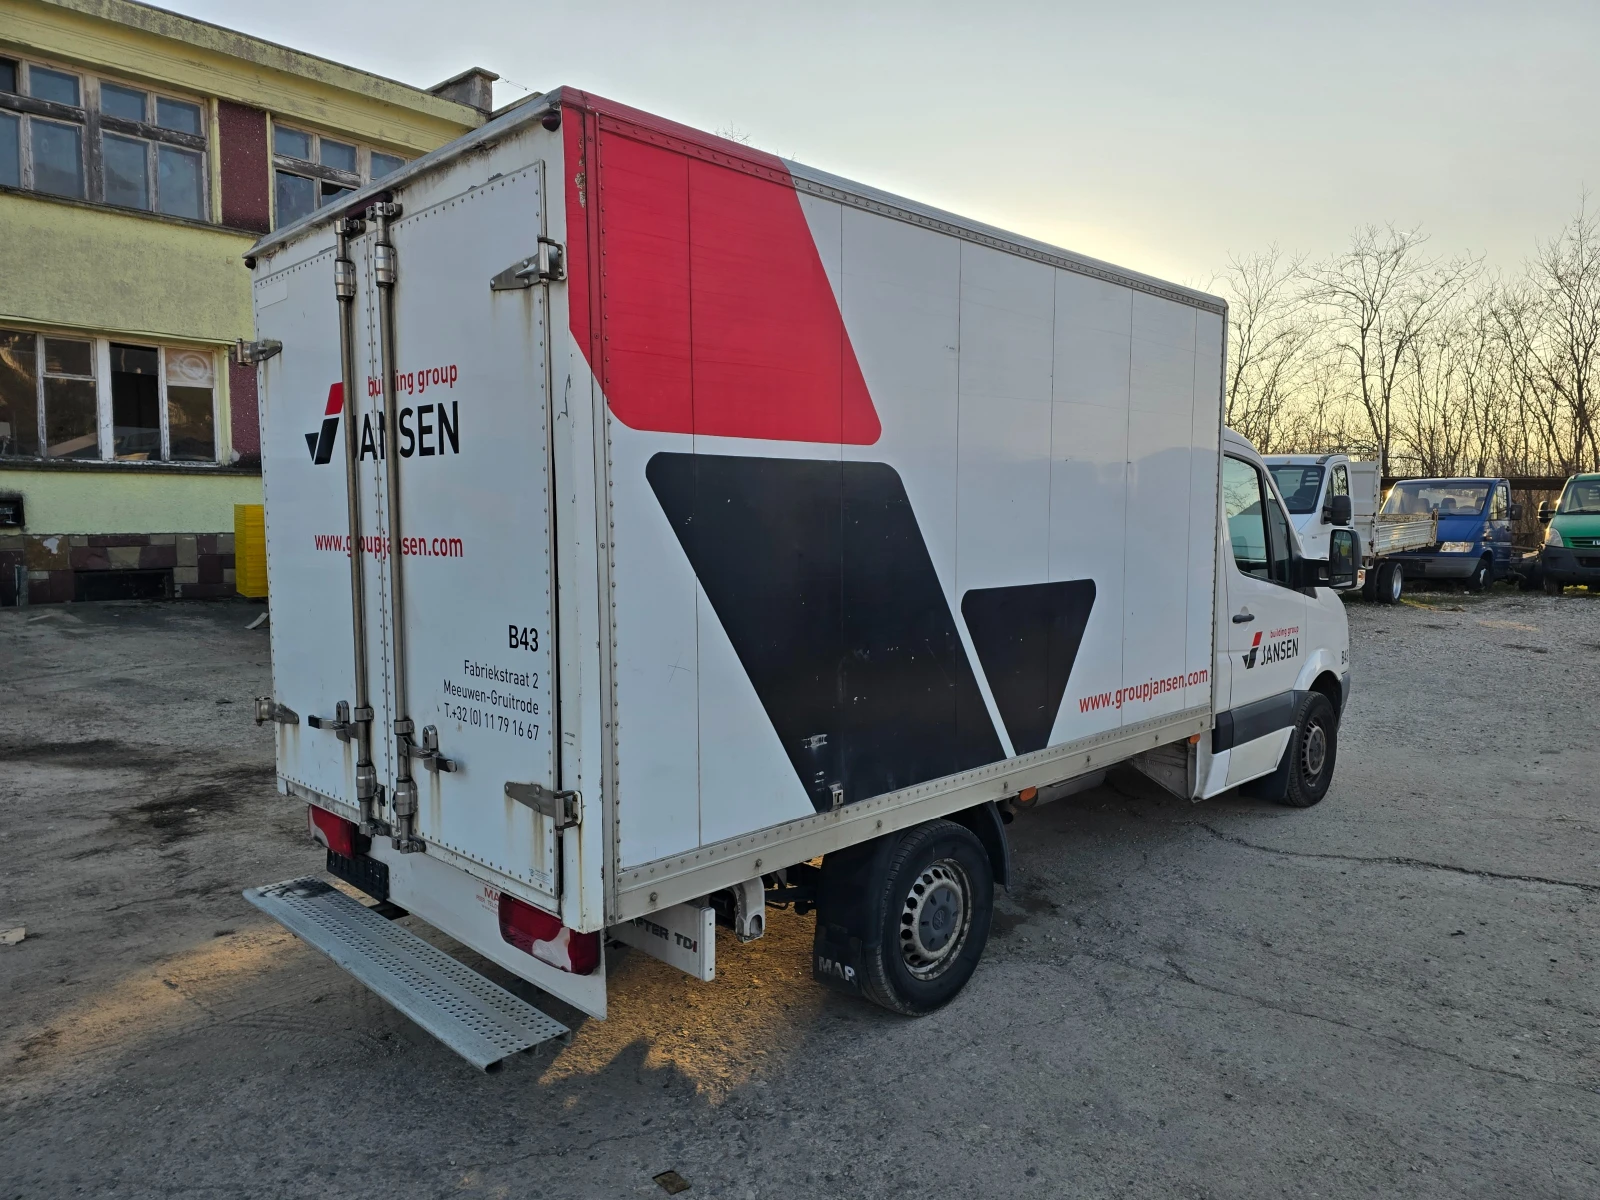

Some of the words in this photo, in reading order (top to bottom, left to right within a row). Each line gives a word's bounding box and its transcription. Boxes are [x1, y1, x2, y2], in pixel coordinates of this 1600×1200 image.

[417, 364, 458, 393] group
[508, 624, 539, 652] B43
[1260, 637, 1299, 666] JANSEN
[464, 659, 530, 688] Fabriekstraat
[532, 672, 539, 690] 2
[443, 678, 539, 715] Meeuwen-Gruitrode
[1079, 669, 1208, 713] www.groupjansen.com
[484, 712, 495, 730] 11
[497, 715, 510, 733] 79
[512, 719, 524, 737] 16
[527, 723, 539, 741] 67
[674, 932, 698, 953] TDI
